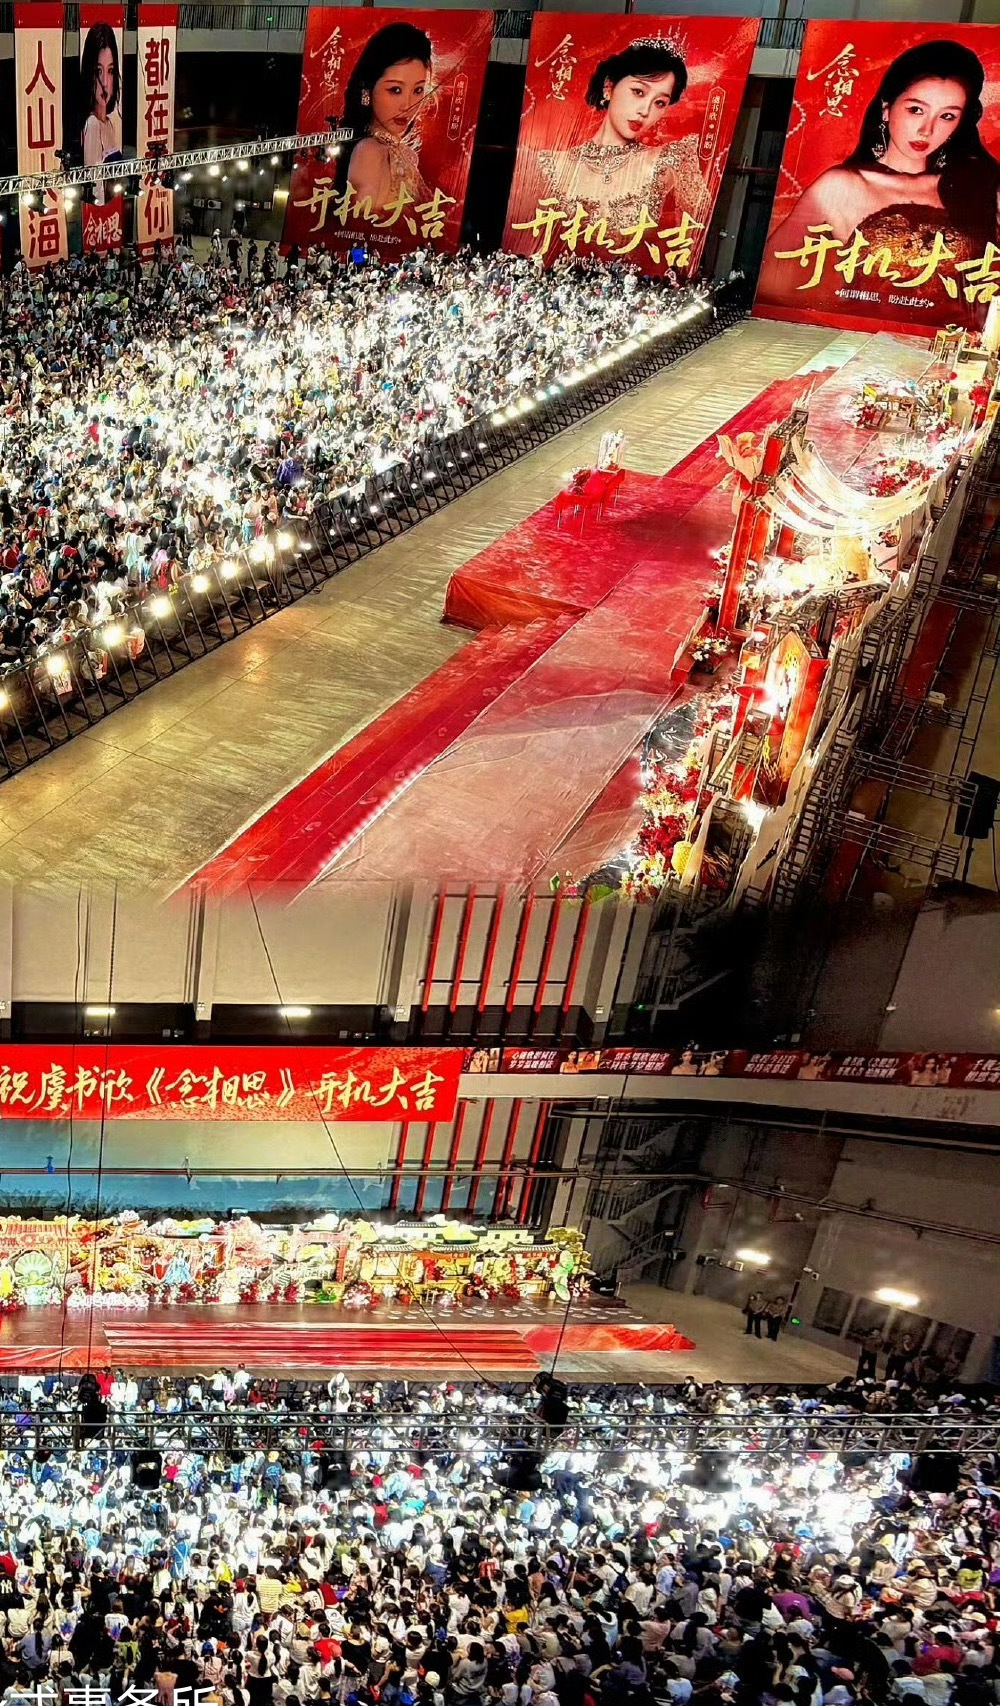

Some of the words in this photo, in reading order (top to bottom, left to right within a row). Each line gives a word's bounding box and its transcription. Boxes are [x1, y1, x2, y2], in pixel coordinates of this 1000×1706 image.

[535, 34, 577, 100] 念相思
[806, 43, 860, 117] 念相思
[82, 211, 123, 245] 念相思
[293, 177, 456, 239] 开机大吉
[512, 198, 704, 266] 开机大吉
[774, 223, 1000, 303] 开机大吉
